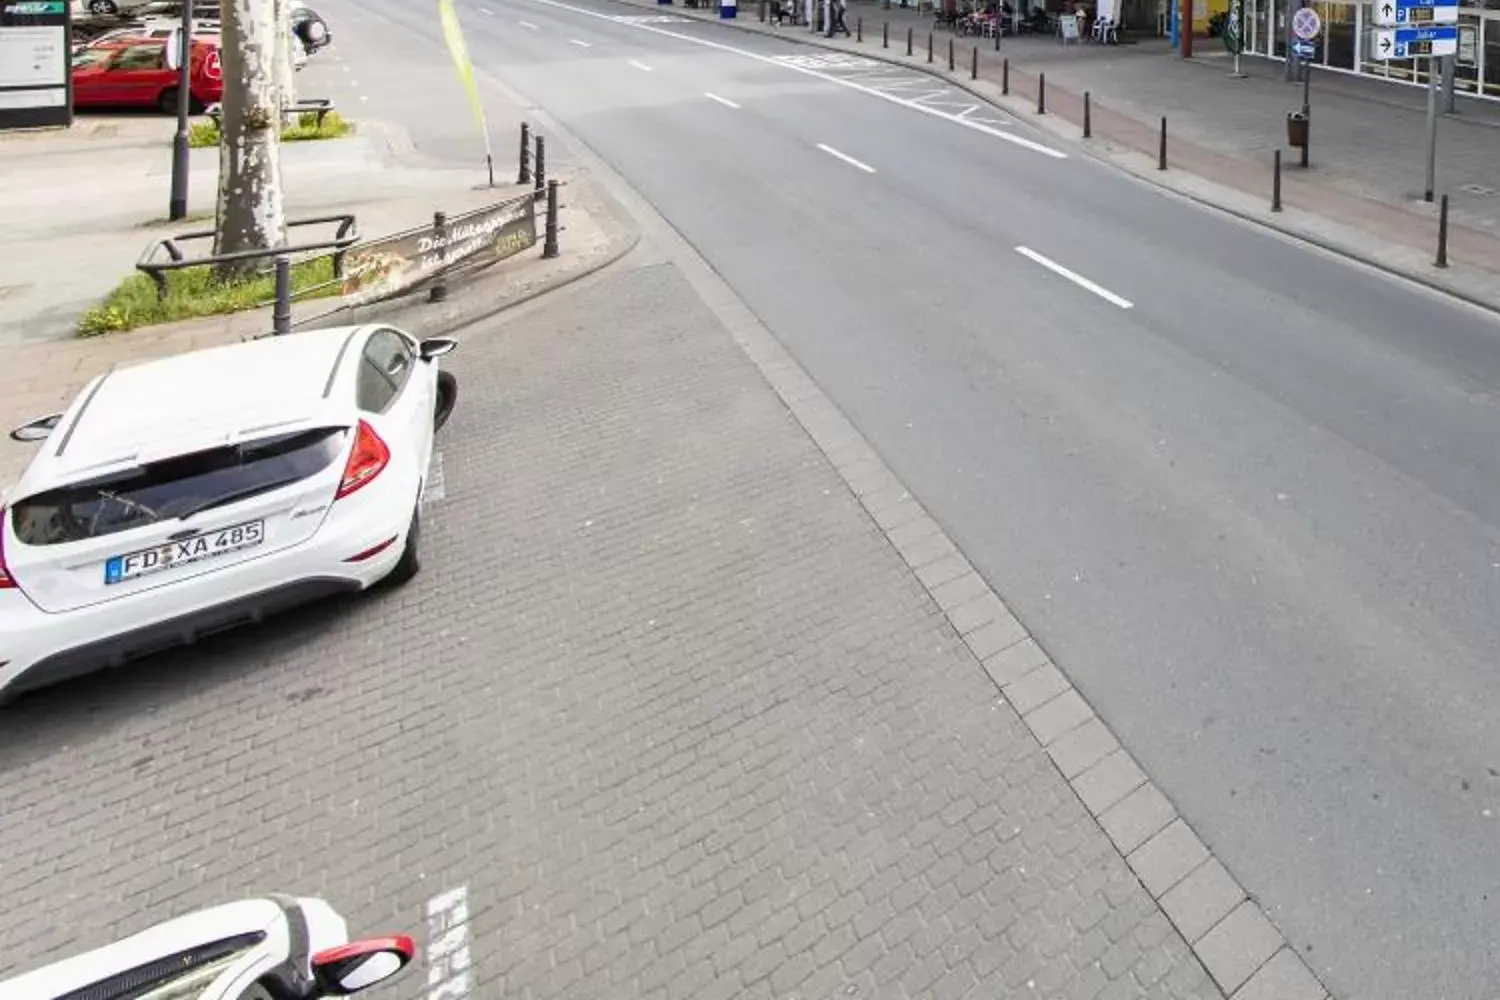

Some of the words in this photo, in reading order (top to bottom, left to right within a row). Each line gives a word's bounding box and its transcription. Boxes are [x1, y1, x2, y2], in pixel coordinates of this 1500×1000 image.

[124, 550, 159, 573] FD
[176, 539, 208, 559] XA
[214, 524, 261, 547] 485
